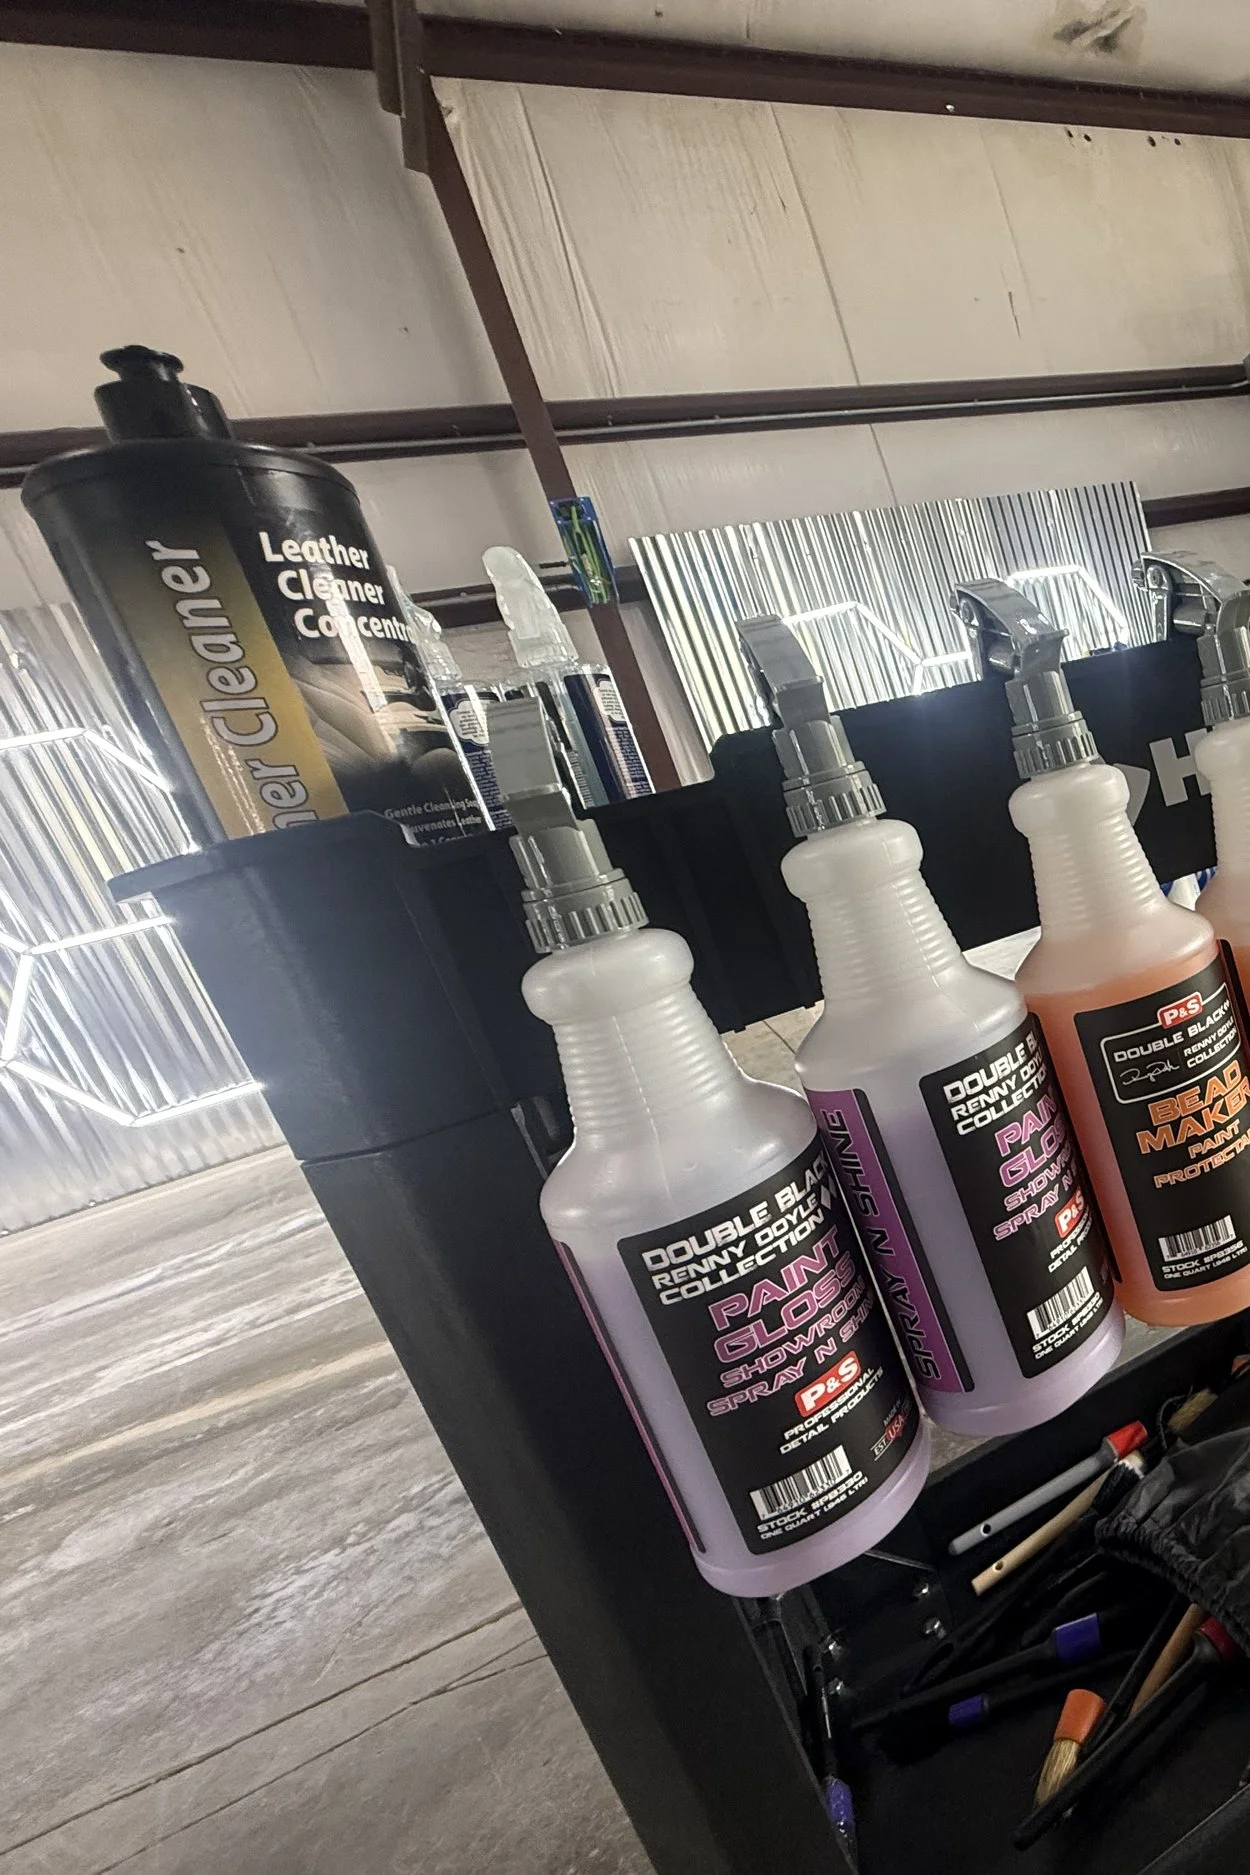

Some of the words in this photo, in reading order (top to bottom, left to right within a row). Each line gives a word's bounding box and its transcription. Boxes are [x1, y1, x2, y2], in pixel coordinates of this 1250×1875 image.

[259, 531, 370, 570] Leather
[277, 568, 386, 606] Cleaner
[145, 540, 279, 746] Cleaner
[384, 804, 422, 819] Gentle
[1114, 1031, 1184, 1063] DOUBLE
[1187, 1008, 1225, 1038] BLACK
[1163, 998, 1200, 1026] P&S
[1184, 1033, 1217, 1057] RENNY
[943, 1042, 1027, 1104] DOUBLE
[951, 1075, 1017, 1121] RENNY
[1148, 1060, 1242, 1127] BEAD
[822, 1109, 880, 1217] SHINE
[1188, 1118, 1241, 1160] PAINT
[642, 1201, 772, 1272] DOUBLE
[993, 1183, 1059, 1241] SPRAY
[1058, 1190, 1084, 1232] P&S
[651, 1240, 747, 1290] RENNY
[755, 1193, 819, 1247] DOYLE
[659, 1209, 825, 1305] COLLECTION
[866, 1227, 895, 1257] N
[1048, 1245, 1077, 1273] DETAIL
[1162, 1260, 1201, 1274] STOCK
[708, 1225, 840, 1331] PAINT
[1164, 1272, 1182, 1280] ONE
[1183, 1263, 1211, 1277] QUART
[714, 1250, 856, 1363] GLOSS
[879, 1264, 941, 1381] SPRAY
[1032, 1323, 1070, 1353] STOCK
[1035, 1345, 1053, 1360] ONE
[1054, 1325, 1079, 1348] QUART
[707, 1357, 807, 1416] SPRAY
[814, 1337, 837, 1364] N
[784, 1367, 875, 1440] PROFESSIONAL
[800, 1356, 860, 1412] P&S
[780, 1424, 829, 1454] DETAIL
[831, 1366, 884, 1424] PRODUCTS
[888, 1414, 905, 1439] USA
[757, 1507, 808, 1533] STOCK
[811, 1471, 863, 1511] #PB330
[761, 1528, 783, 1540] ONE
[785, 1510, 822, 1533] QUART
